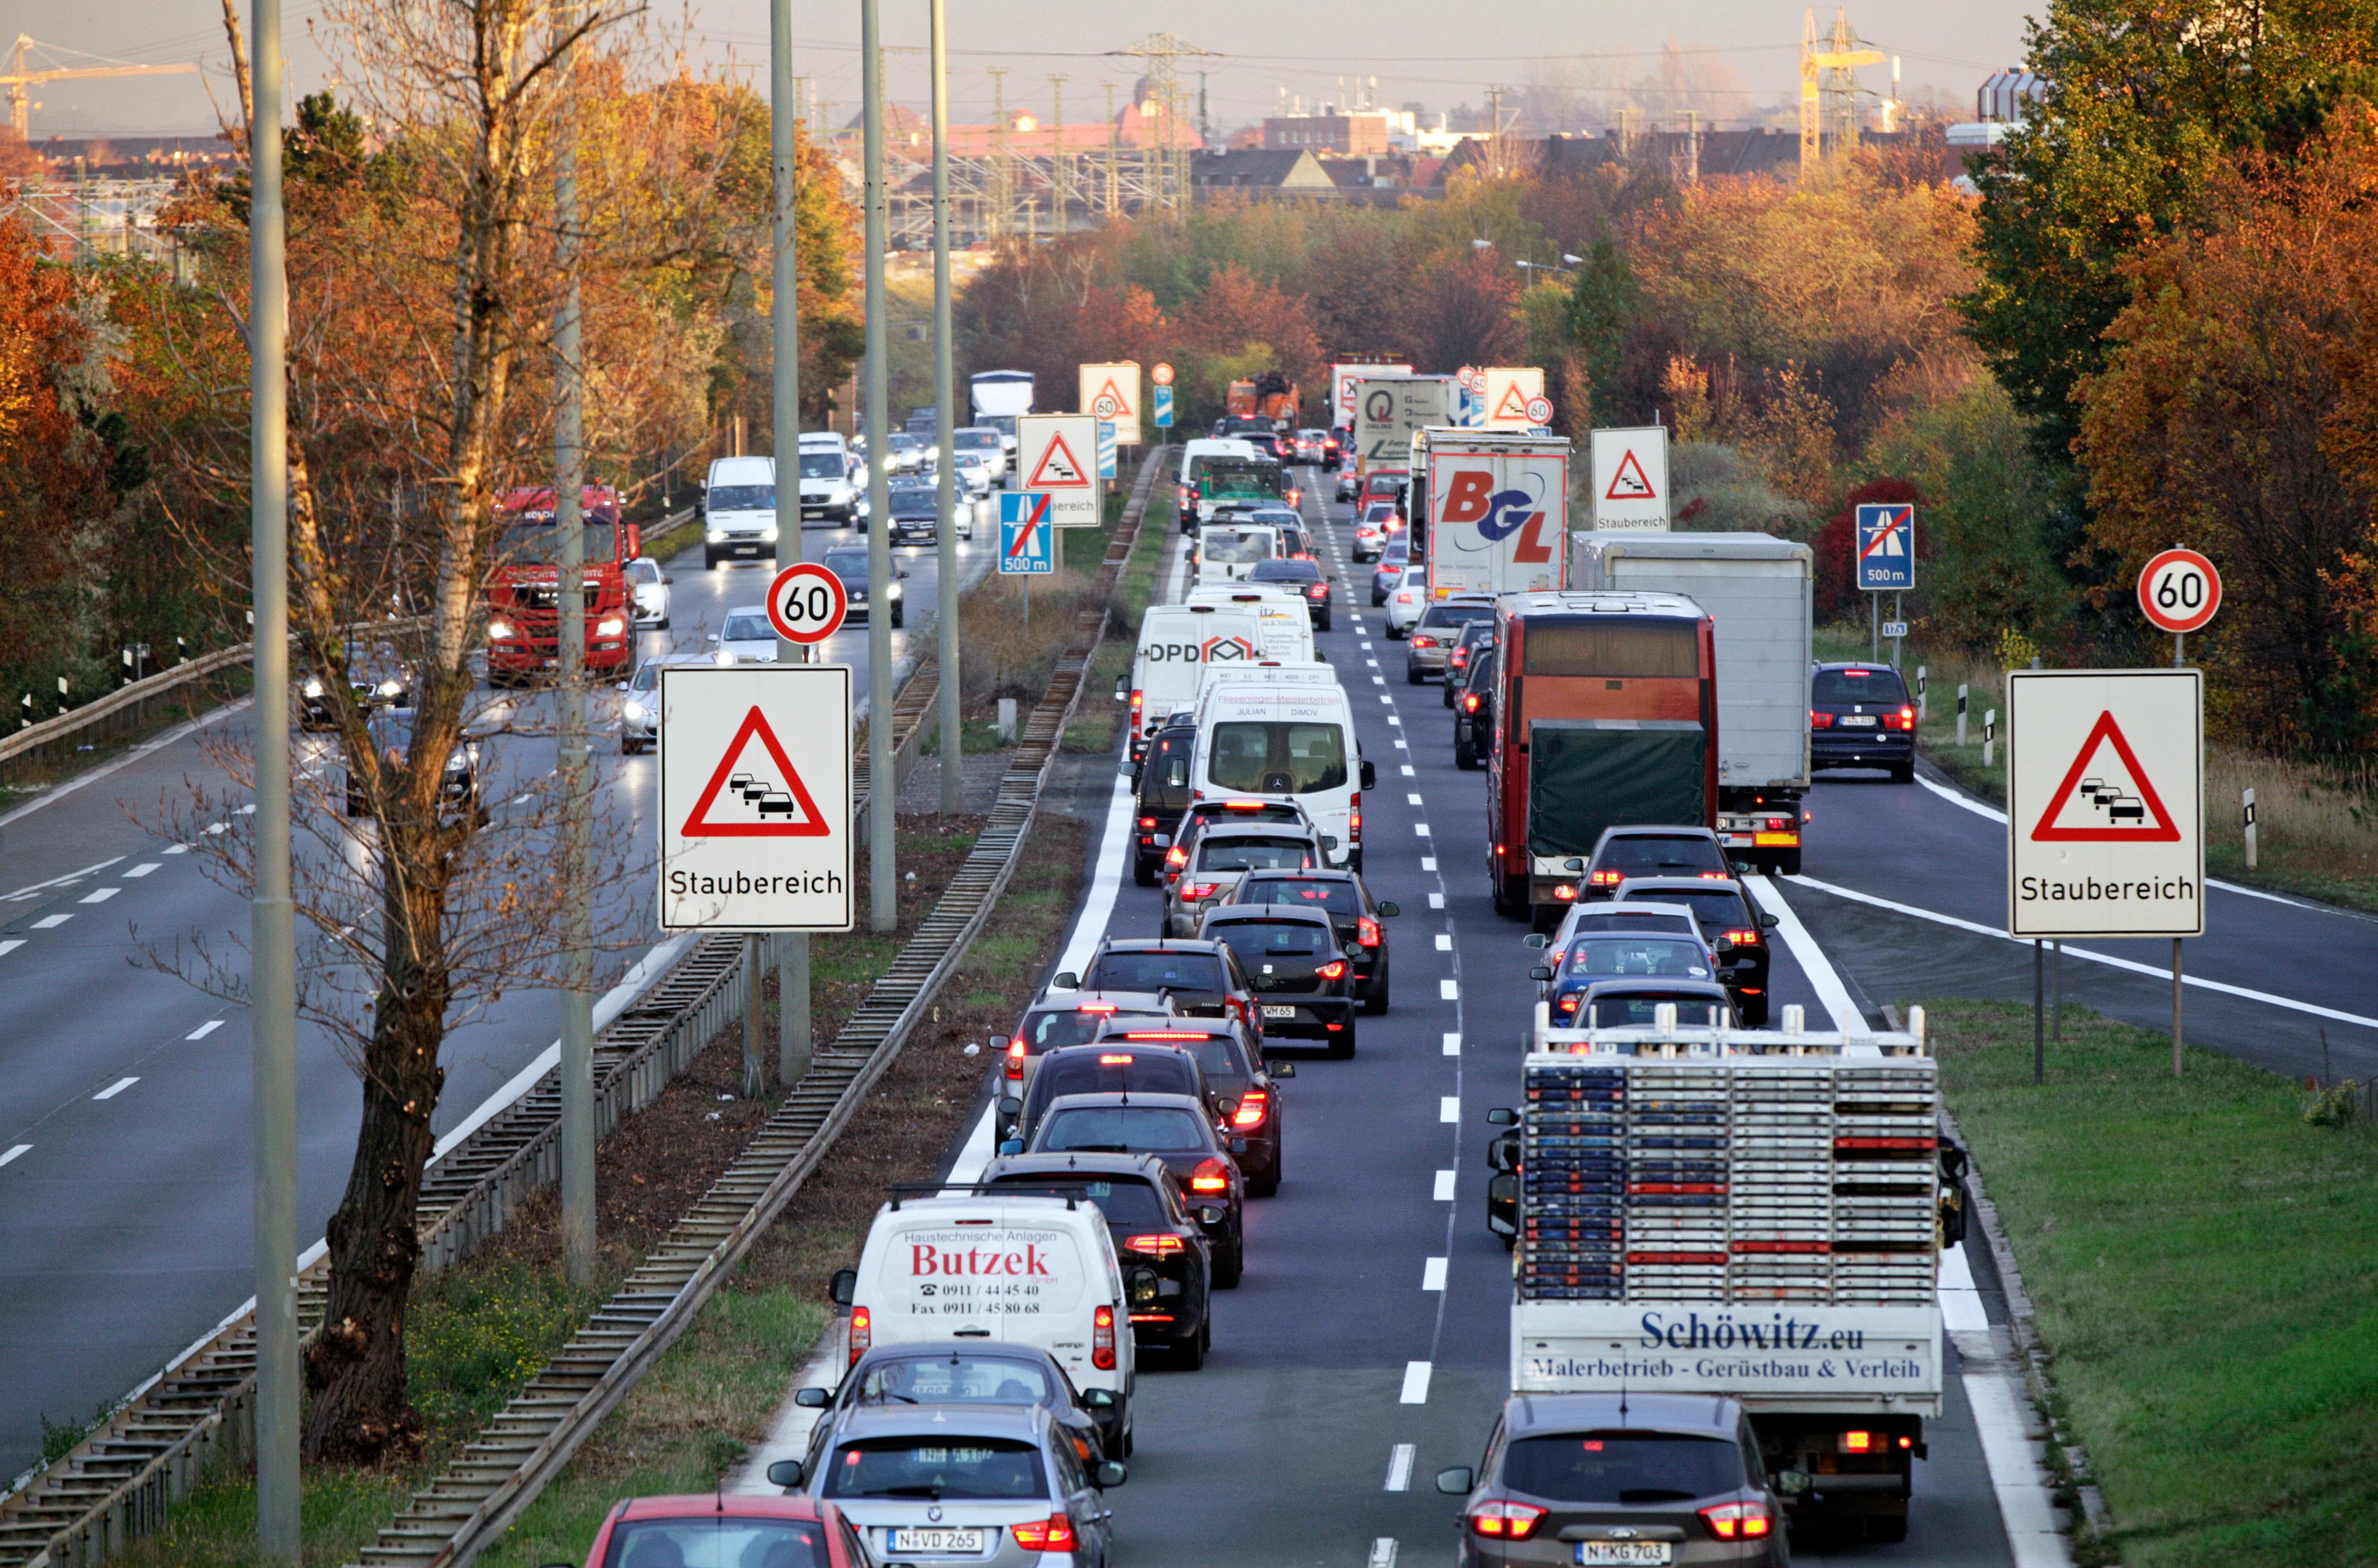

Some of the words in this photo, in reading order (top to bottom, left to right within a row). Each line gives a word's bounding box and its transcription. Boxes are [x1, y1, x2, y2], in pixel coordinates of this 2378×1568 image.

[1098, 400, 1113, 413] 60
[1530, 404, 1547, 416] 60
[1441, 470, 1552, 563] BGL
[1598, 516, 1666, 529] Staubereich
[1004, 557, 1030, 571] 500
[1033, 560, 1047, 570] m
[1867, 569, 1890, 581] 500
[1892, 571, 1905, 580] m
[2158, 572, 2202, 608] 60
[785, 586, 828, 621] 60
[1150, 643, 1200, 662] DPD
[1218, 695, 1341, 704] Fliesenleger-Meisterbetrieb
[670, 870, 842, 894] Staubereich
[2020, 875, 2193, 901] Staubereich
[1266, 1007, 1277, 1016] WM
[1280, 1007, 1291, 1016] 65
[905, 1231, 1003, 1243] Haustechnische
[1006, 1231, 1057, 1244] Anlagen
[909, 1244, 1050, 1276] Butzek
[943, 1285, 972, 1295] 0911
[985, 1285, 1000, 1295] 44
[1004, 1285, 1020, 1295] 45
[1023, 1285, 1039, 1295] 40
[912, 1303, 935, 1314] Fax
[943, 1303, 972, 1314] 0911
[985, 1303, 1001, 1314] 45
[1005, 1303, 1020, 1314] 80
[1024, 1303, 1040, 1314] 68
[1641, 1311, 1863, 1350] Schöwitz.eu
[1533, 1358, 1674, 1377] Malerbetrieb
[1696, 1358, 1810, 1378] Gerüstbau
[1817, 1358, 1836, 1378] &
[1845, 1359, 1920, 1378] Verleih
[900, 1534, 910, 1547] N
[922, 1534, 941, 1547] VD
[947, 1534, 975, 1547] 265
[1588, 1545, 1599, 1558] N
[1609, 1545, 1630, 1558] KG
[1634, 1545, 1662, 1558] 703
